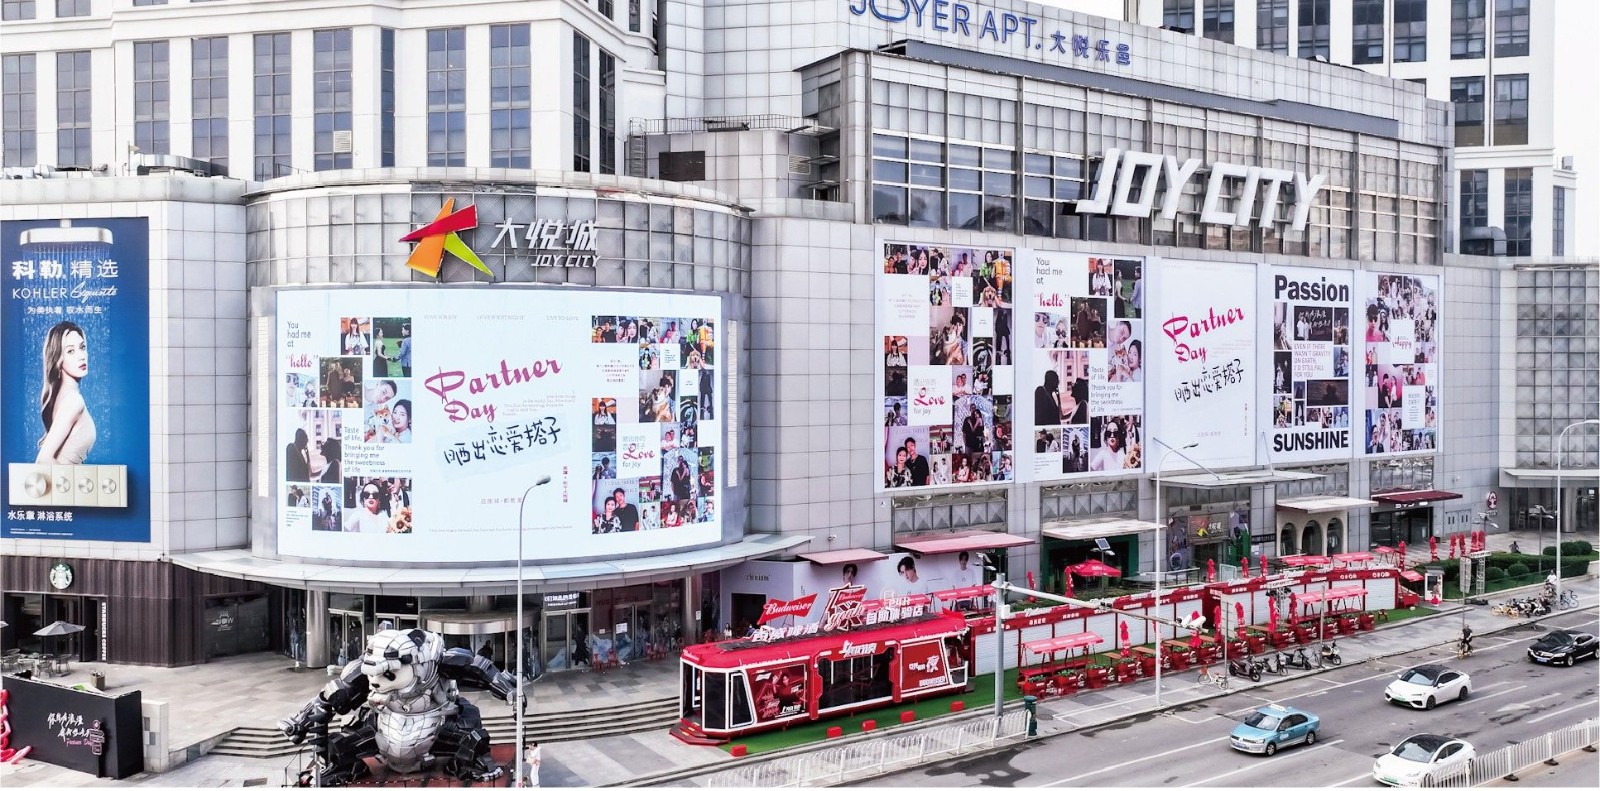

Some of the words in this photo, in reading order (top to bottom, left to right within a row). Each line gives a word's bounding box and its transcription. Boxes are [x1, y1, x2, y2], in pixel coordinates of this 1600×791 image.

[979, 10, 1042, 49] APT.
[1050, 31, 1131, 64] 大悦乐邑
[1075, 148, 1203, 220] JOY
[1200, 162, 1327, 231] CITY
[491, 217, 600, 251] 大悦城
[12, 260, 63, 279] 科勒
[70, 259, 118, 278] 精选
[531, 255, 563, 267] JOY
[565, 255, 601, 268] CITY
[1036, 257, 1050, 265] You
[1036, 267, 1050, 275] had
[1036, 277, 1044, 285] at
[1274, 274, 1349, 302] Passion
[12, 287, 68, 299] KOHLER
[286, 330, 300, 338] had
[287, 321, 299, 329] You
[1162, 306, 1244, 343] Partner
[1175, 343, 1207, 363] Day
[424, 359, 563, 403] Partner
[1174, 358, 1244, 403] 晒出恋爱搭子
[914, 387, 945, 406] Love
[444, 398, 498, 423] Day
[443, 416, 562, 466] 晒出恋爱搭子
[1272, 430, 1349, 453] SUNSHINE
[622, 443, 655, 460] Love
[37, 511, 73, 521] 淋浴系统
[763, 602, 813, 615] Budweiser
